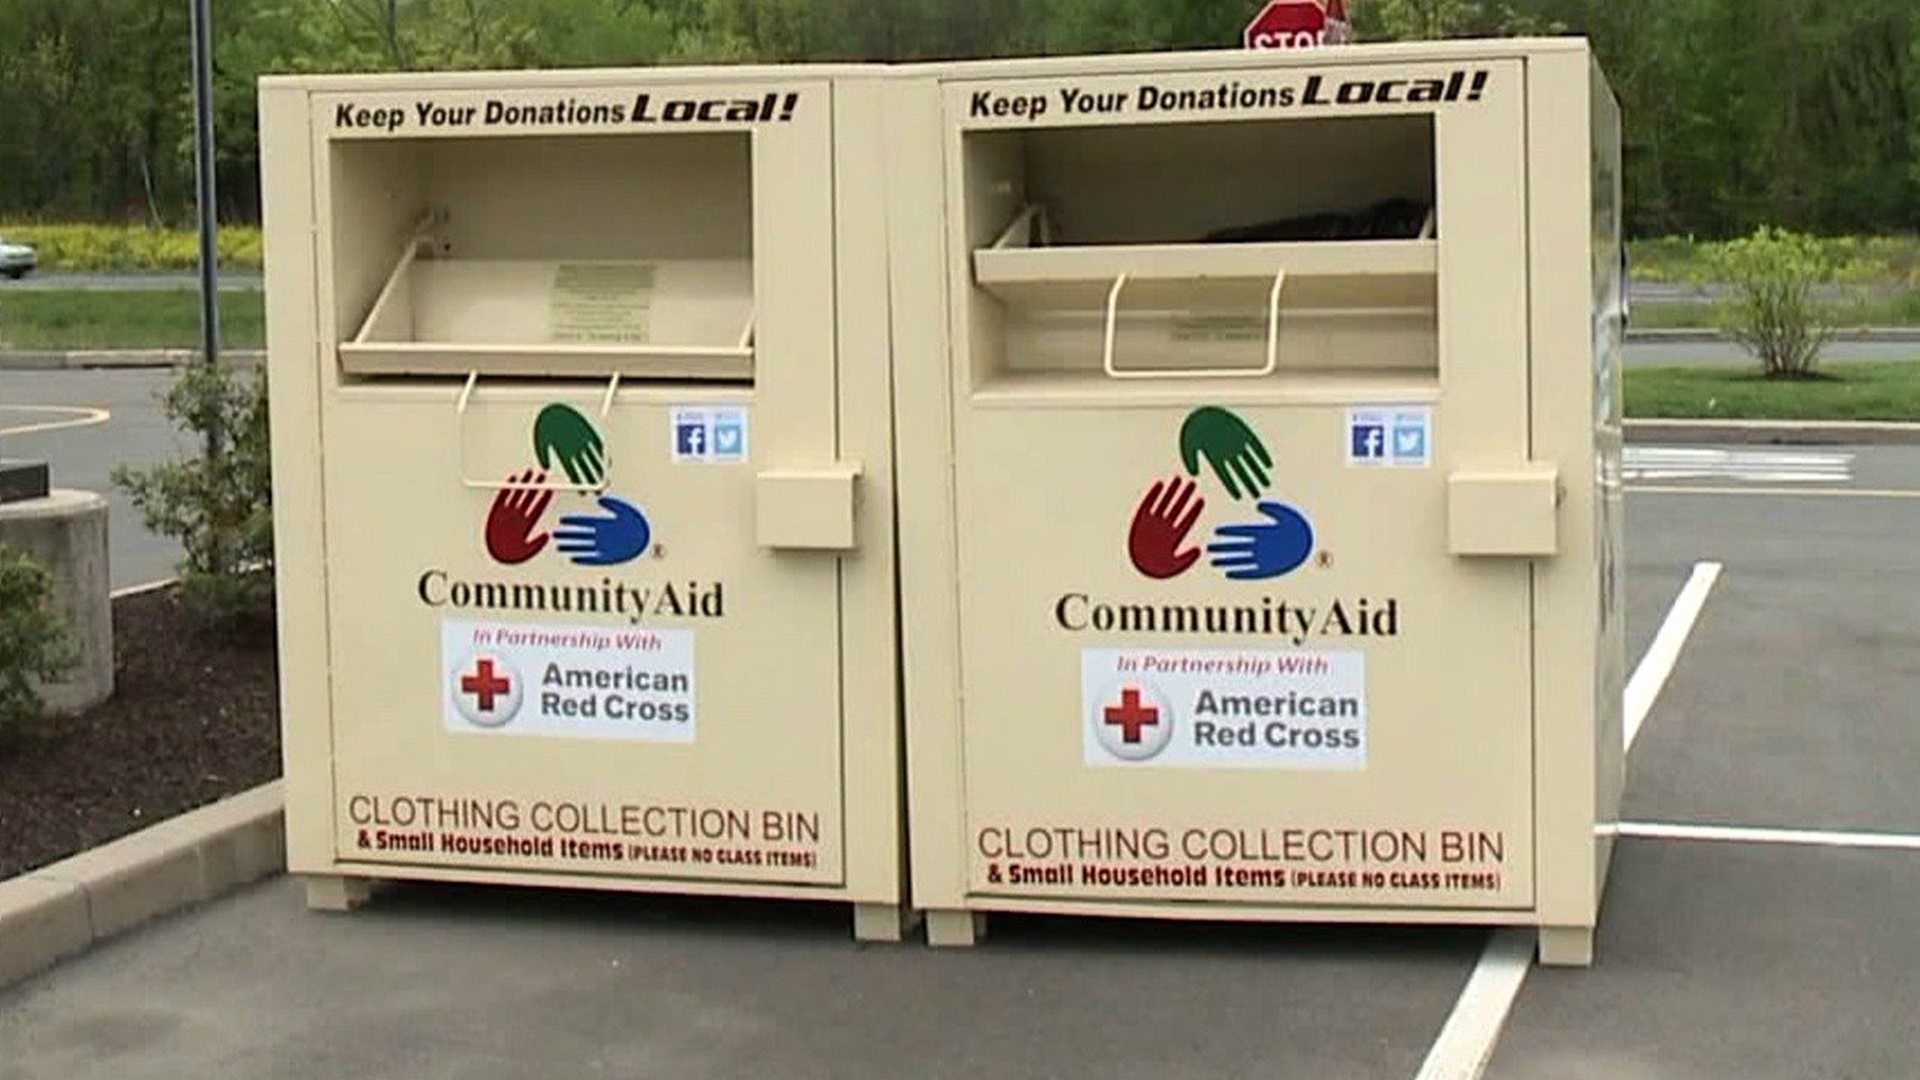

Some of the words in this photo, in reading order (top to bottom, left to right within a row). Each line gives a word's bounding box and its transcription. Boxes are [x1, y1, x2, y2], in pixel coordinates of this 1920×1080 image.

[971, 91, 1047, 120] Keep
[1060, 88, 1128, 114] Your
[1137, 82, 1295, 111] Donations
[1302, 71, 1488, 105] Local!
[336, 103, 405, 132] Keep
[416, 102, 476, 126] Your
[484, 98, 625, 125] Donations
[631, 93, 798, 122] Local!
[473, 629, 491, 643] In
[496, 629, 611, 651] Partnership
[615, 634, 662, 651] With
[542, 662, 689, 692] American
[1117, 656, 1138, 672] In
[1143, 656, 1271, 676] Partnership
[1278, 657, 1329, 676] With
[541, 692, 596, 718] Red
[604, 695, 689, 723] Cross
[1195, 690, 1359, 718] American
[1194, 721, 1256, 747] Red
[1265, 724, 1361, 749] Cross
[350, 796, 520, 830] CLOTHING
[531, 802, 749, 840] COLLECTION
[763, 810, 819, 842] BIN
[358, 829, 371, 848] &
[376, 830, 434, 851] Small
[441, 833, 553, 858] Household
[560, 838, 623, 861] Items
[692, 849, 713, 865] NO
[978, 827, 1170, 859] CLOTHING
[1182, 828, 1427, 862] COLLECTION
[1441, 831, 1503, 863] BIN
[988, 864, 1001, 883] &
[1009, 864, 1073, 885] Small
[1082, 865, 1207, 887] Household
[1215, 867, 1285, 888] Items
[1362, 873, 1384, 888] NO
